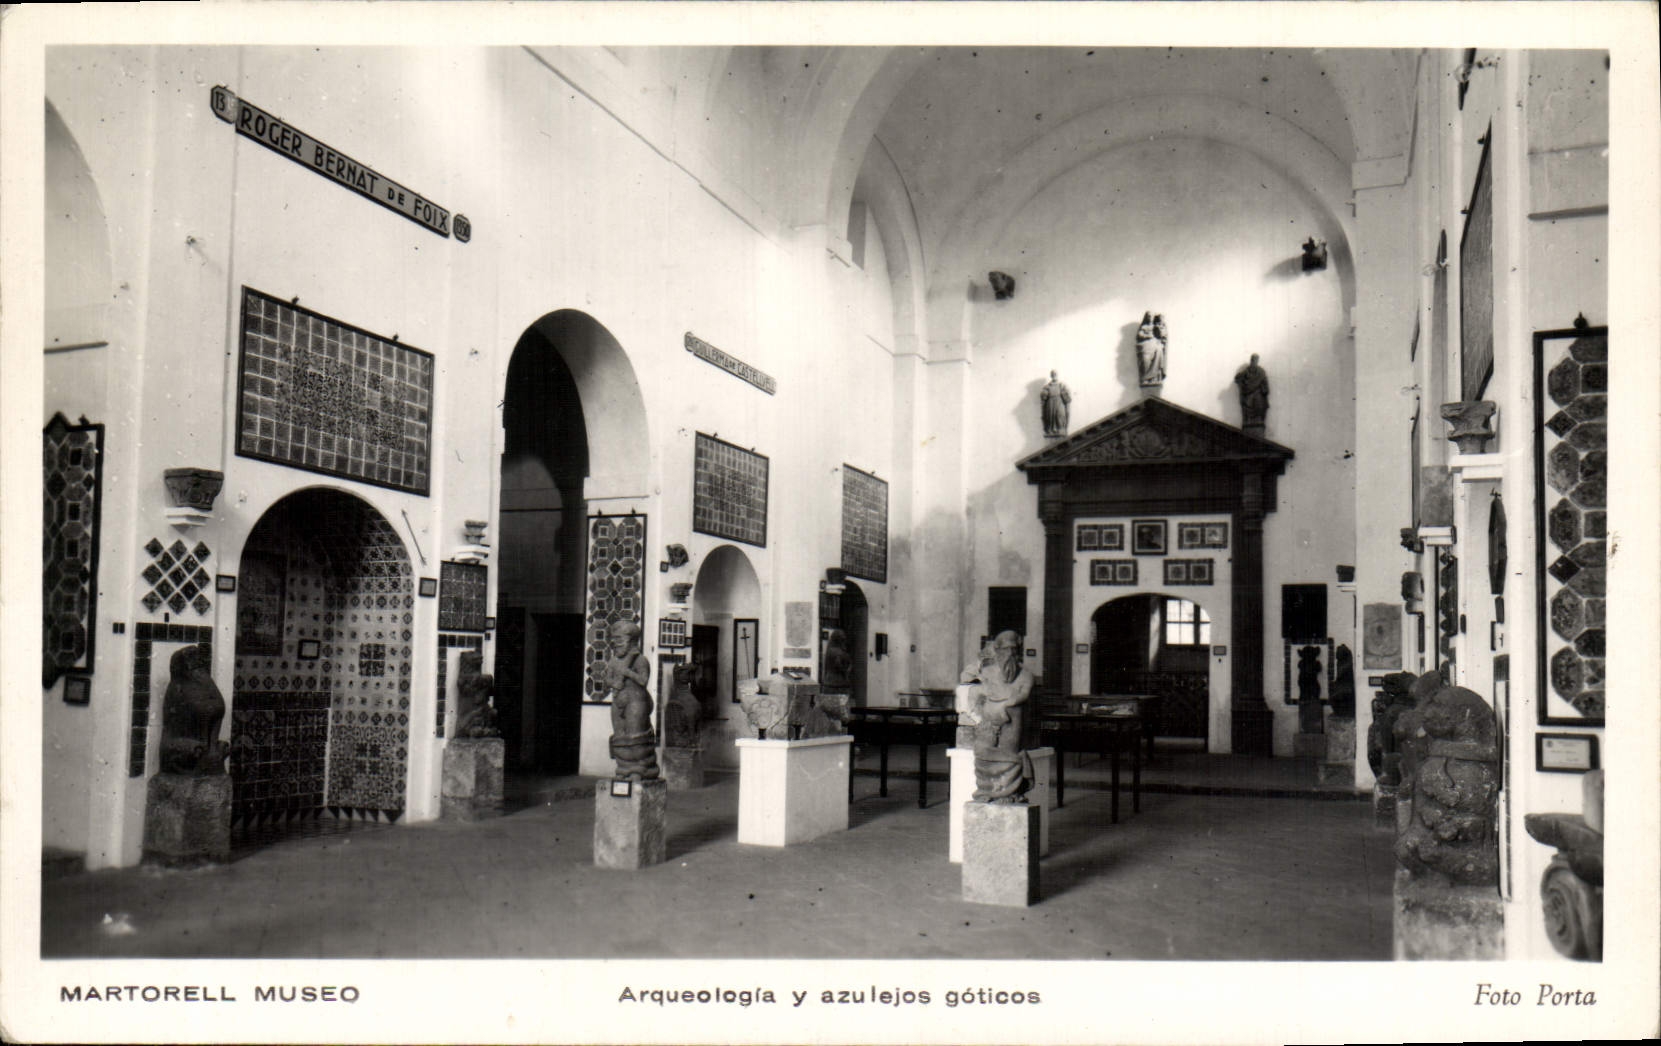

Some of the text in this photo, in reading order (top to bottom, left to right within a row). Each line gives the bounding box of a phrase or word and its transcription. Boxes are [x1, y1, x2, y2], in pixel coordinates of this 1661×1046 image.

[240, 107, 450, 232] ROGER BERNAT DE FOIX
